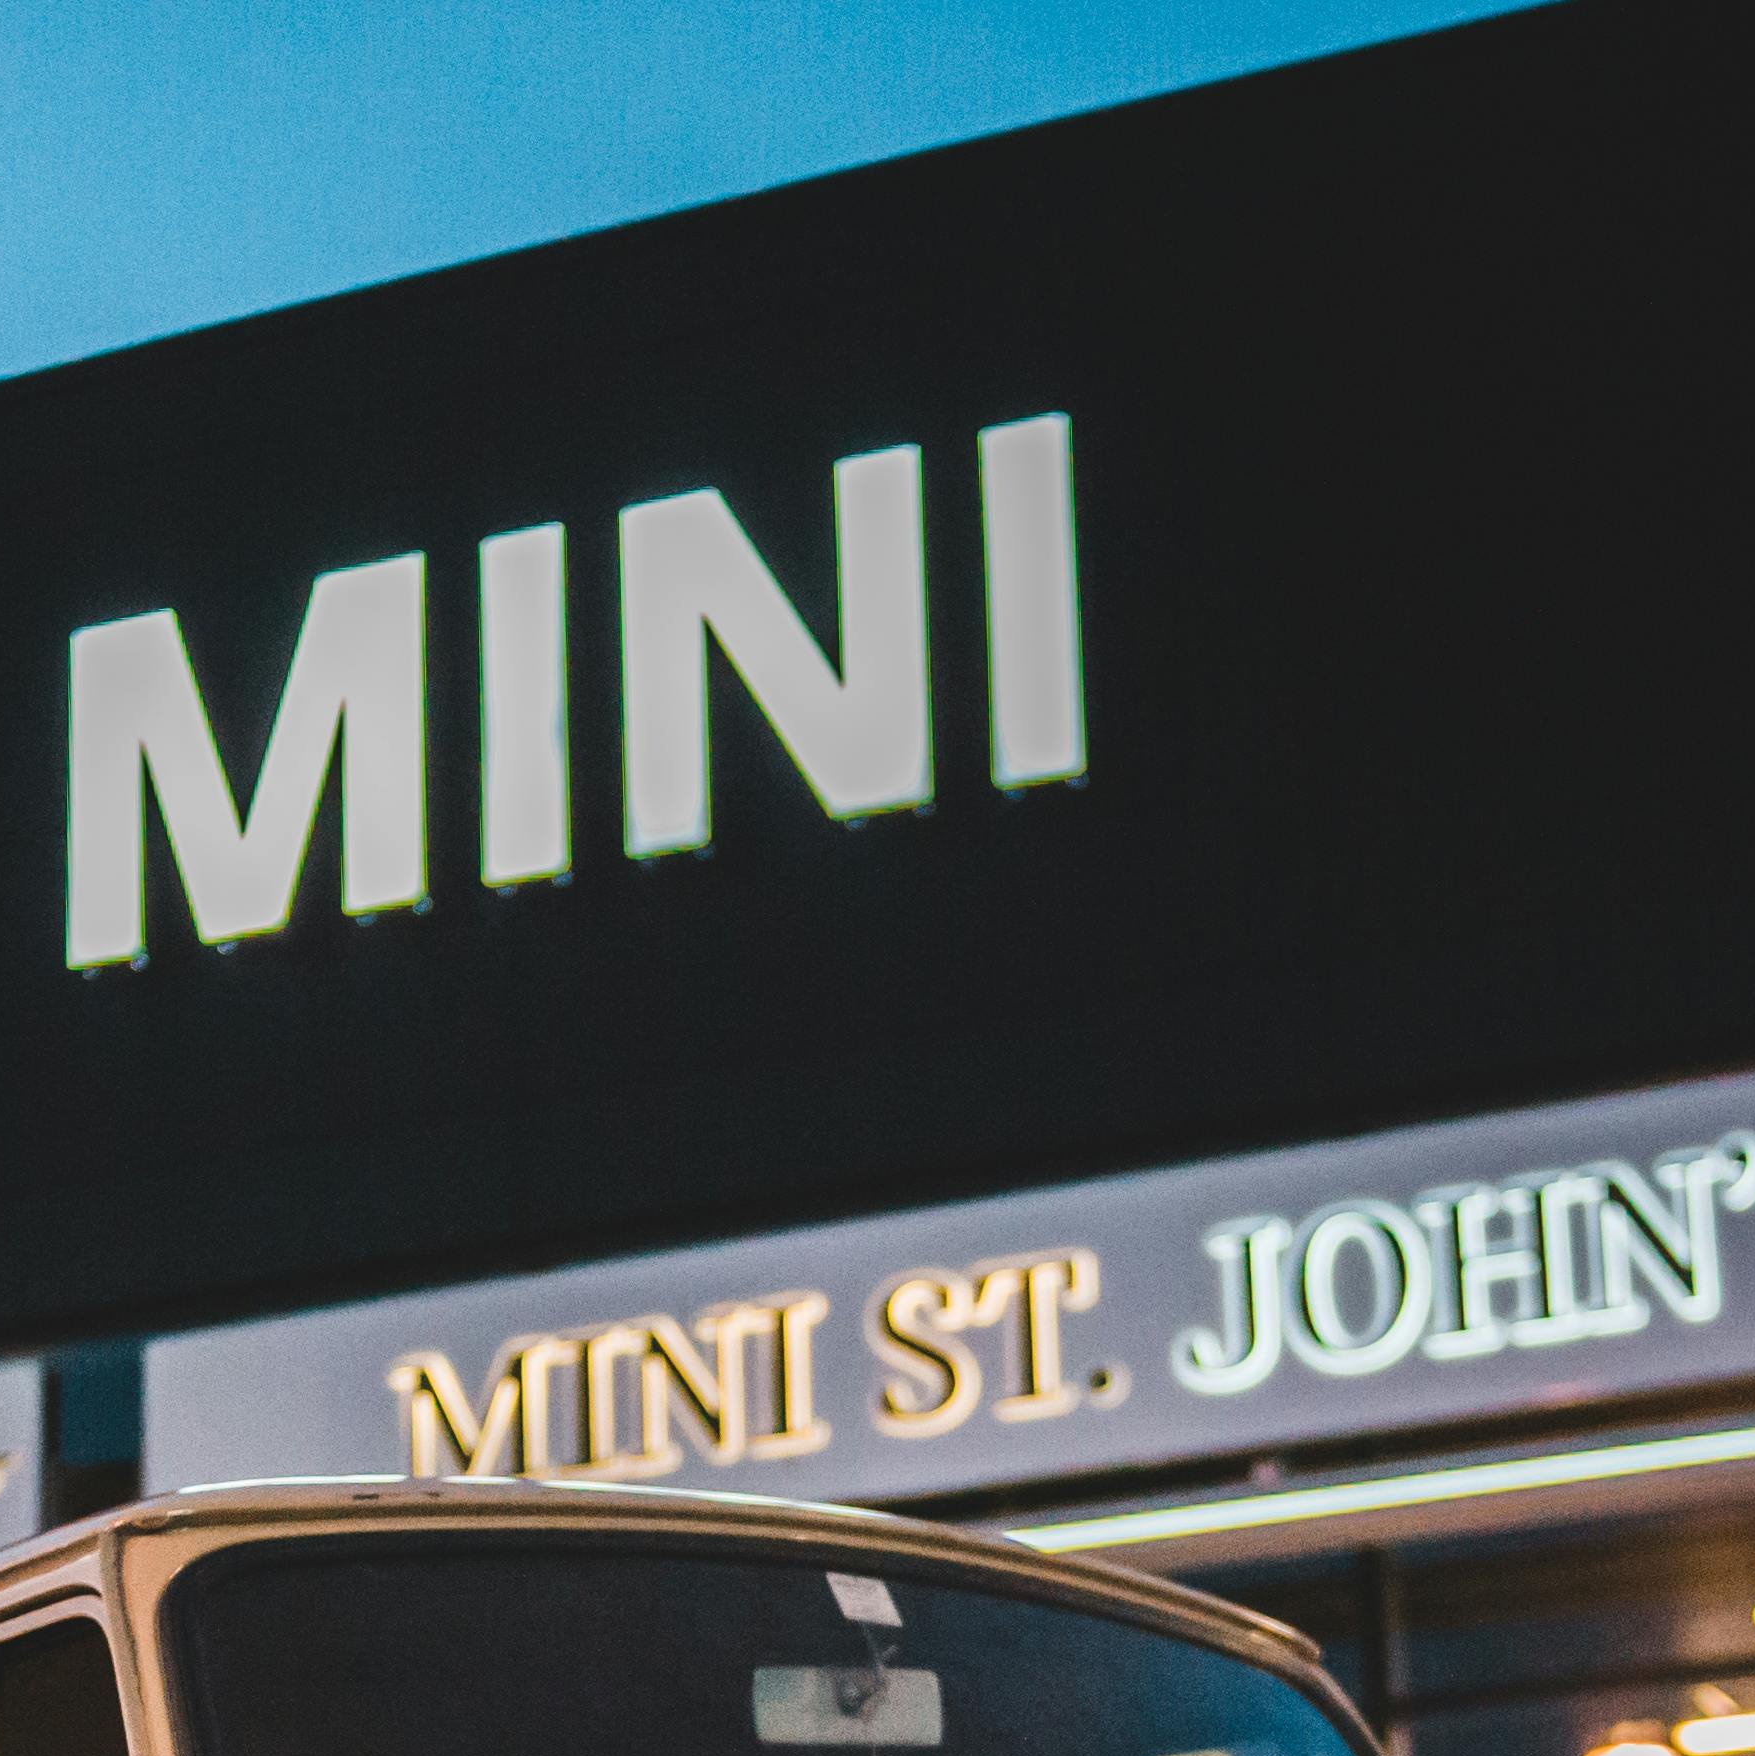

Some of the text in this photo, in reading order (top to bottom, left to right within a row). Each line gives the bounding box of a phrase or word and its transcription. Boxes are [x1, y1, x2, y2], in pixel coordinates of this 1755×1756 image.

[66, 411, 1086, 970] MINI
[385, 1289, 831, 1479] MINI
[863, 1246, 1130, 1440] ST.
